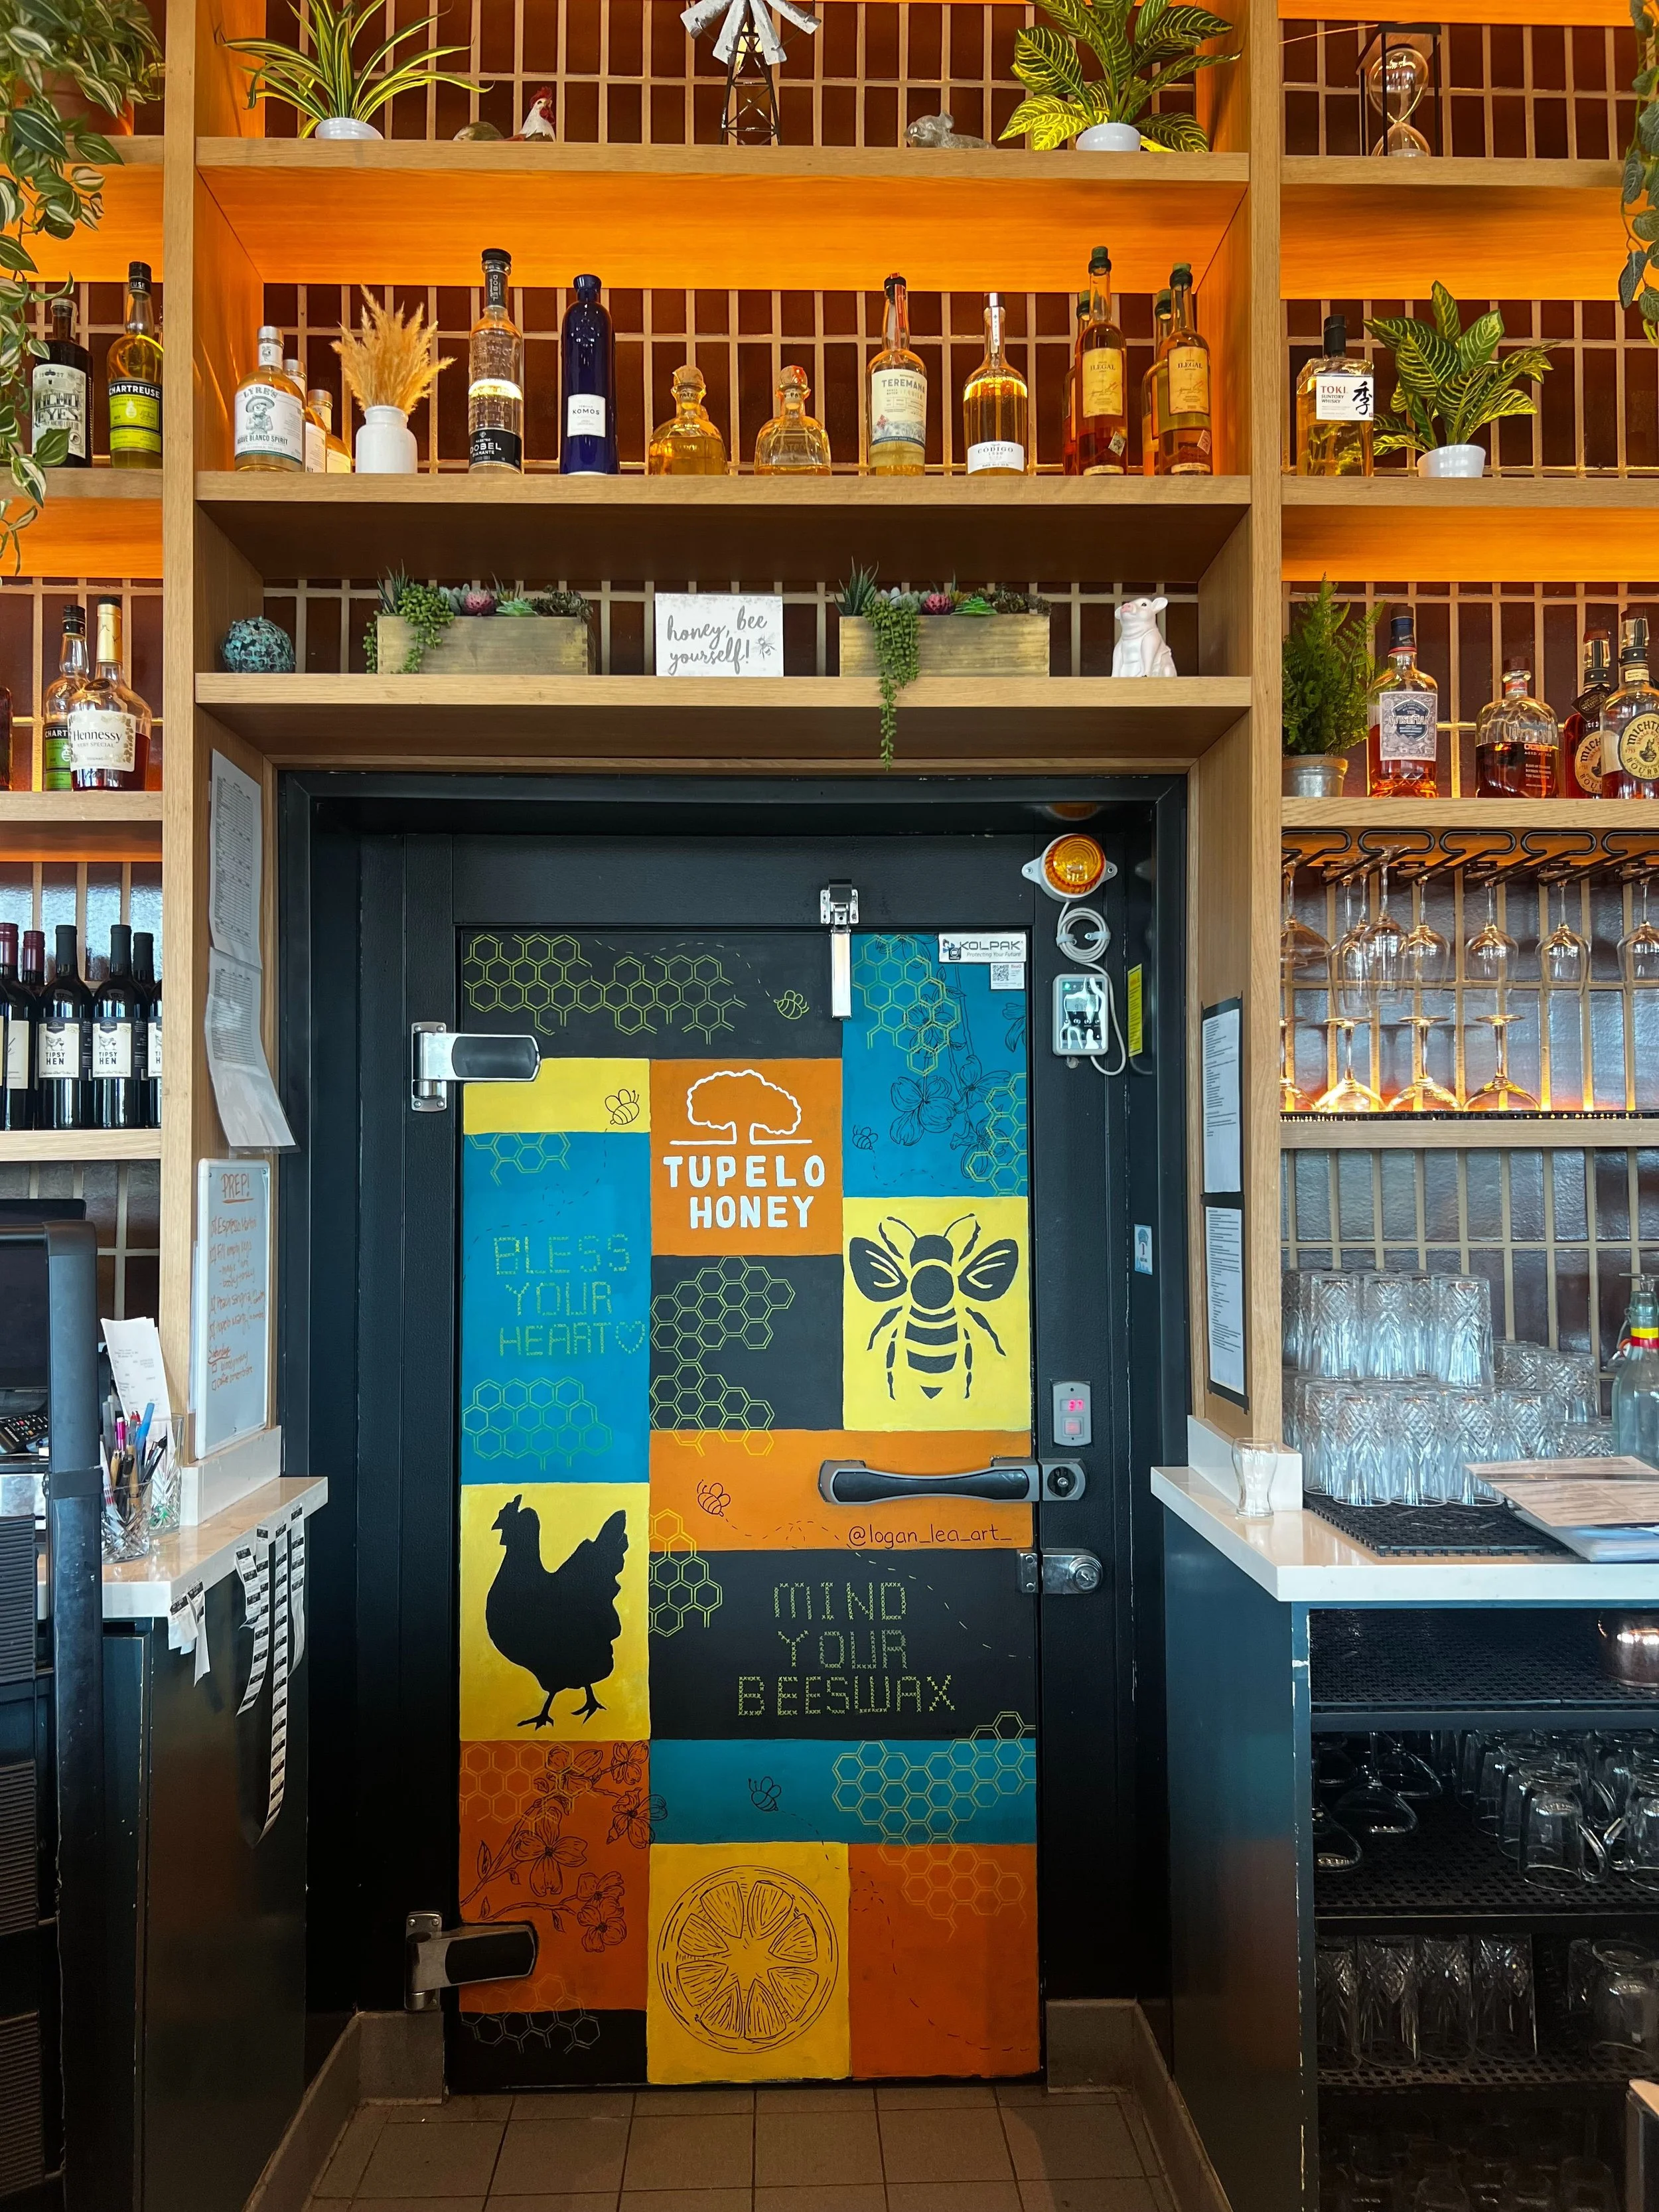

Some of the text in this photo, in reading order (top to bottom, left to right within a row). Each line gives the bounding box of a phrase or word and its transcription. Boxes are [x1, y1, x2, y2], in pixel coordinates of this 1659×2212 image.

[109, 385, 160, 399] CHARTREUSE
[244, 386, 279, 398] LYRE'S
[881, 378, 925, 394] TEREMANA
[1352, 380, 1373, 415] 季
[271, 435, 288, 445] SPIRIT
[470, 442, 502, 455] DOBEL
[667, 605, 768, 650] honey, bee
[668, 636, 750, 676] yourself!
[73, 729, 123, 744] Hennessy
[1389, 715, 1435, 725] WISEMAN
[960, 940, 1021, 950] KOLPAK
[220, 1173, 250, 1199] PREP!
[663, 1155, 826, 1188] TUPELO
[689, 1195, 815, 1229] HONEY
[493, 1234, 630, 1276] BLESS
[506, 1281, 613, 1316] YOUR
[500, 1321, 612, 1357] HEART
[849, 1524, 1013, 1549] @logan_lea_art_
[774, 1582, 906, 1621] MIND
[777, 1629, 908, 1669] YOUR
[738, 1674, 956, 1716] BEESWAX
